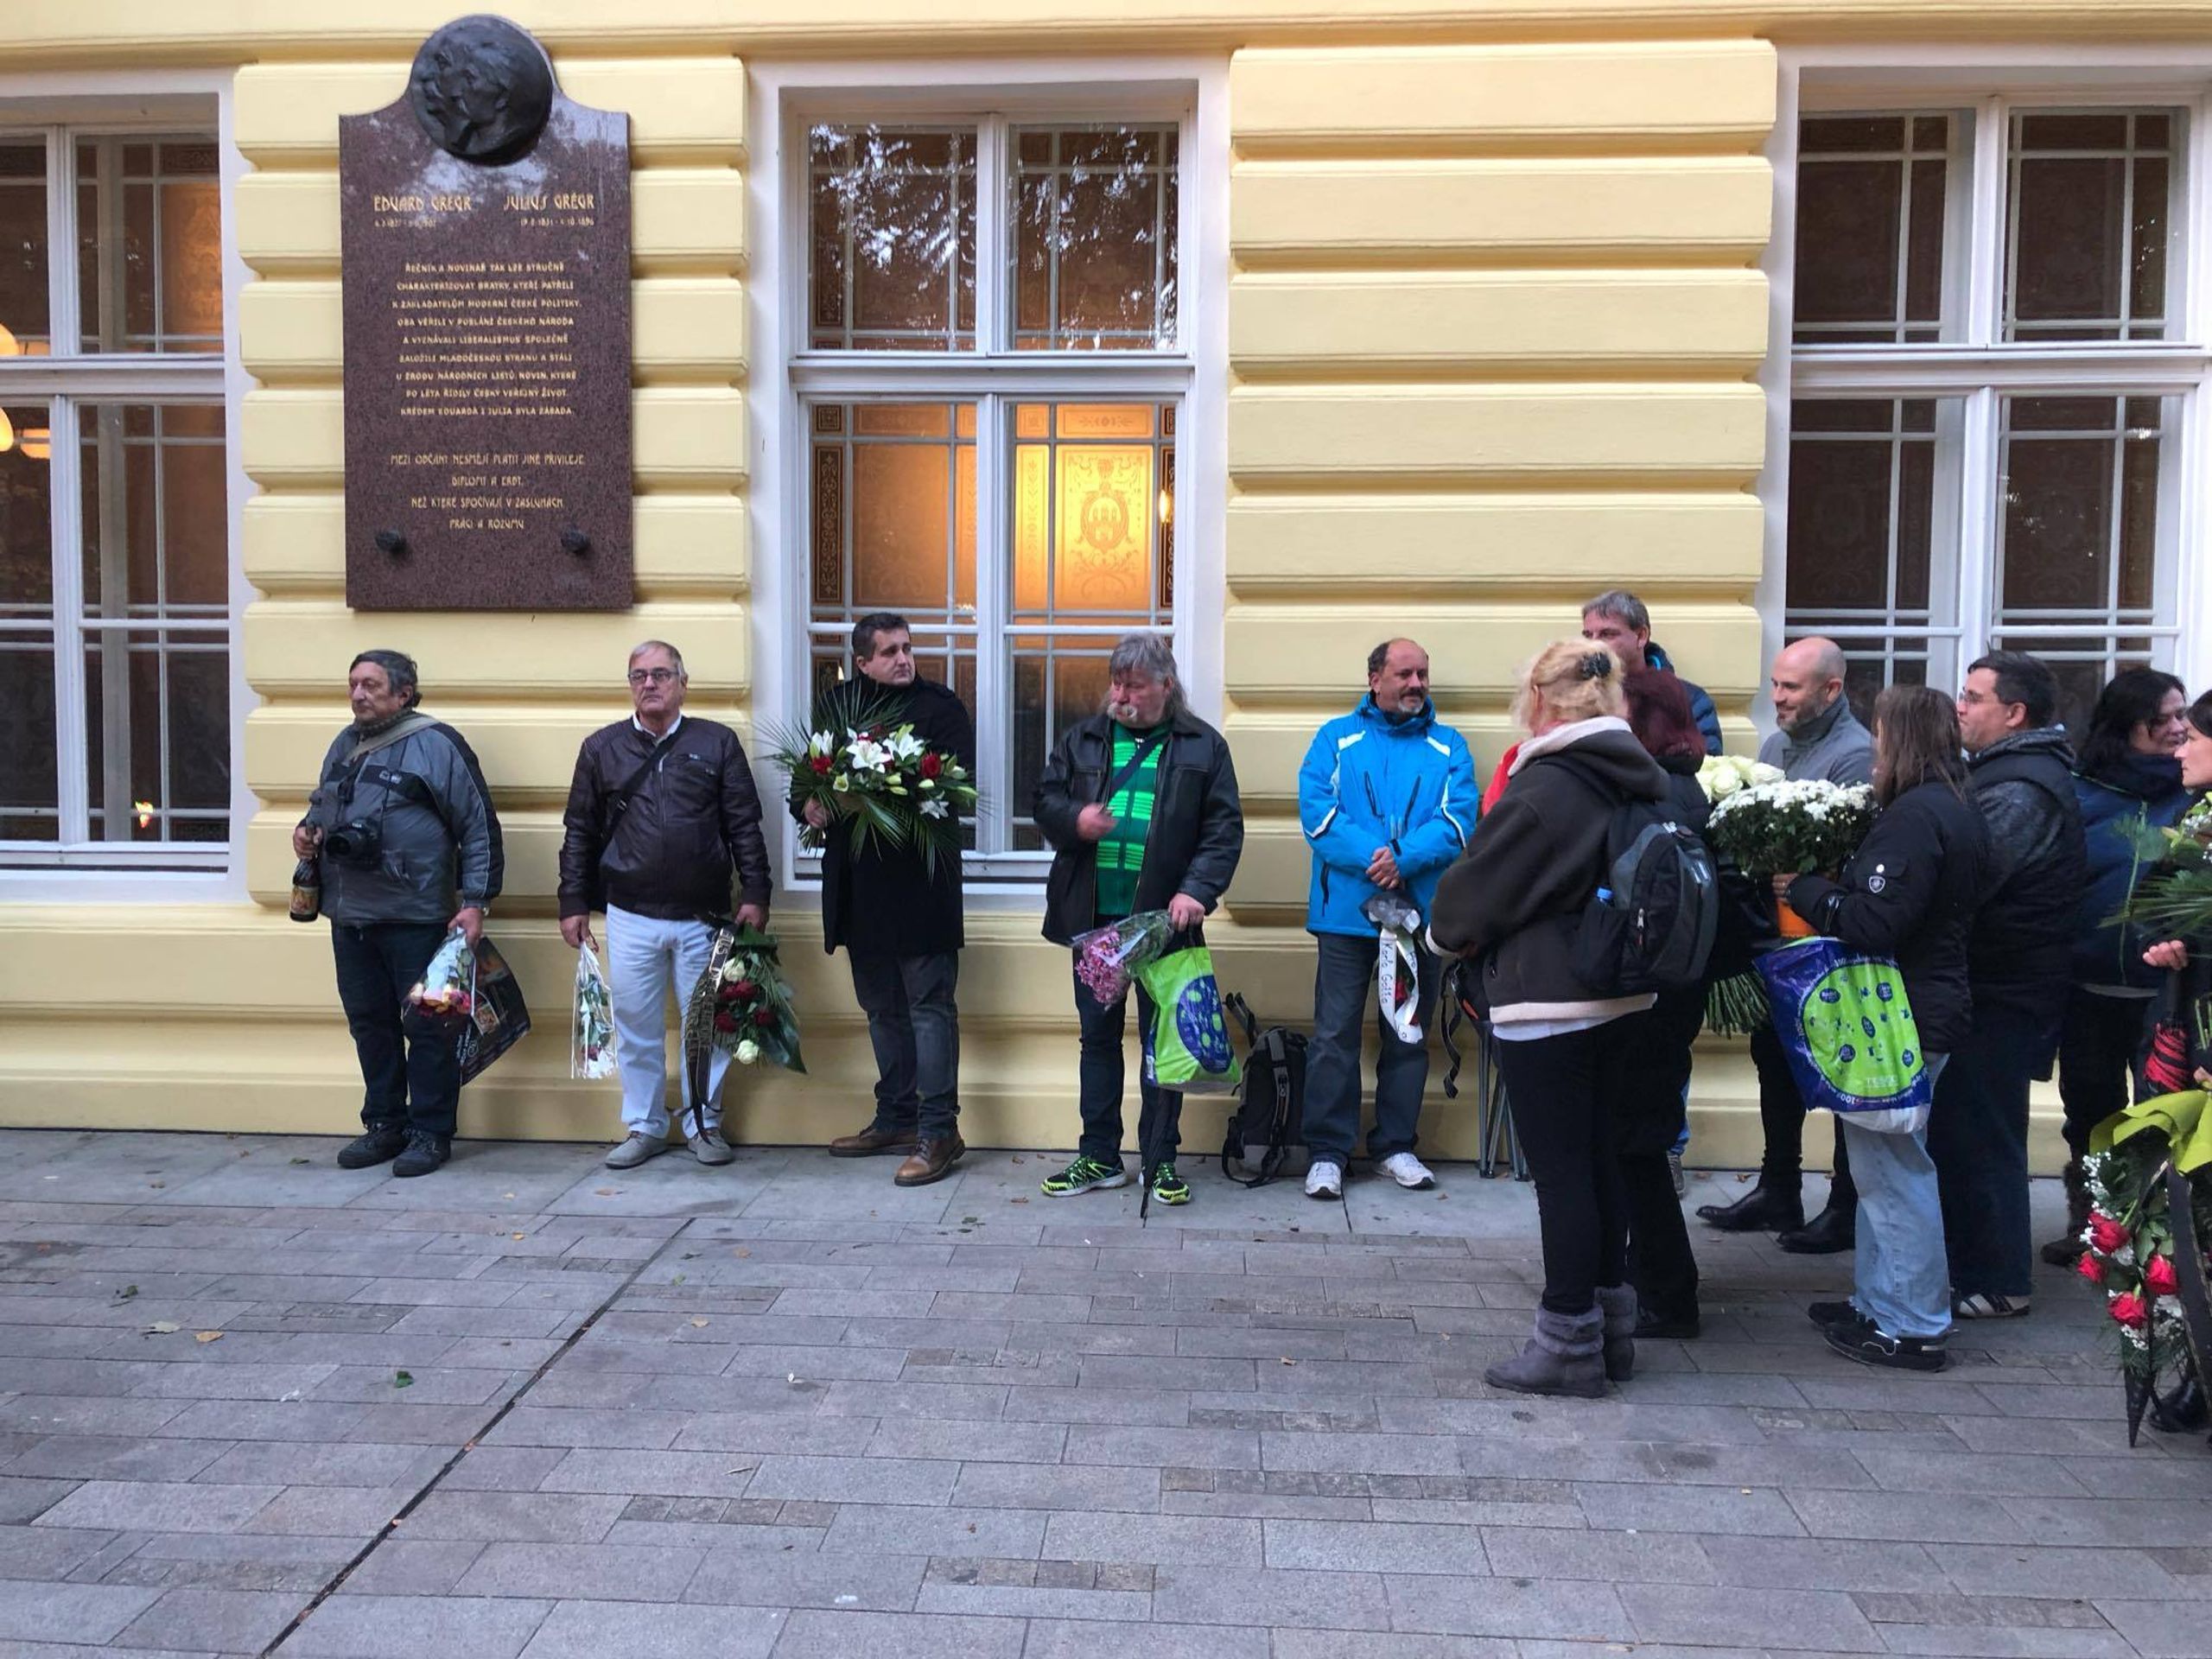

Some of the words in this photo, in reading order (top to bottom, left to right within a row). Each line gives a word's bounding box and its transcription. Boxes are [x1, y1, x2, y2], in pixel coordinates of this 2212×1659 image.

[374, 194, 424, 212] EDUARD
[503, 194, 548, 212] JULIUS
[553, 192, 594, 210] GRÉGR
[397, 282, 475, 291] CHARAKTERIZOVAT
[397, 318, 415, 327] OBA
[506, 498, 512, 507] V
